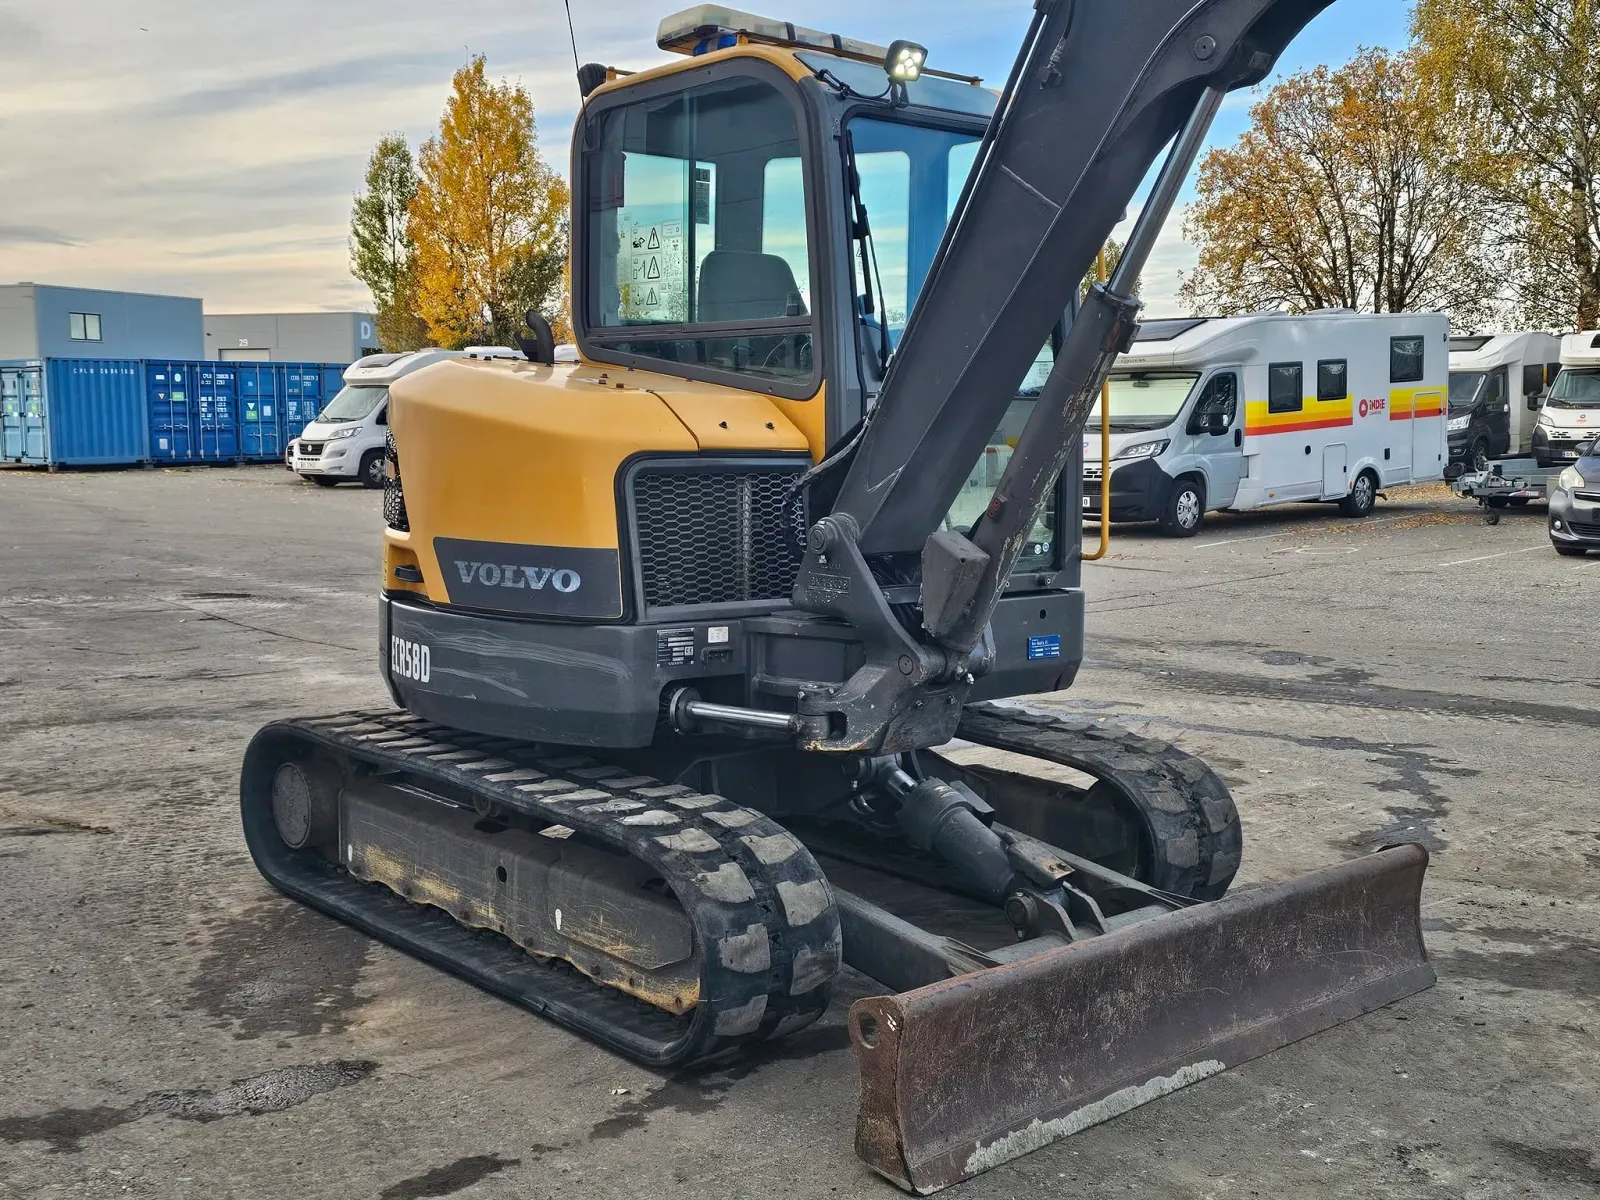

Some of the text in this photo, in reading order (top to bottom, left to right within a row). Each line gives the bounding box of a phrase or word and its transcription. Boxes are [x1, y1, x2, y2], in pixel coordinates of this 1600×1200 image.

[360, 321, 371, 340] D
[454, 560, 581, 592] VOLVO
[391, 634, 431, 683] ECR58D
